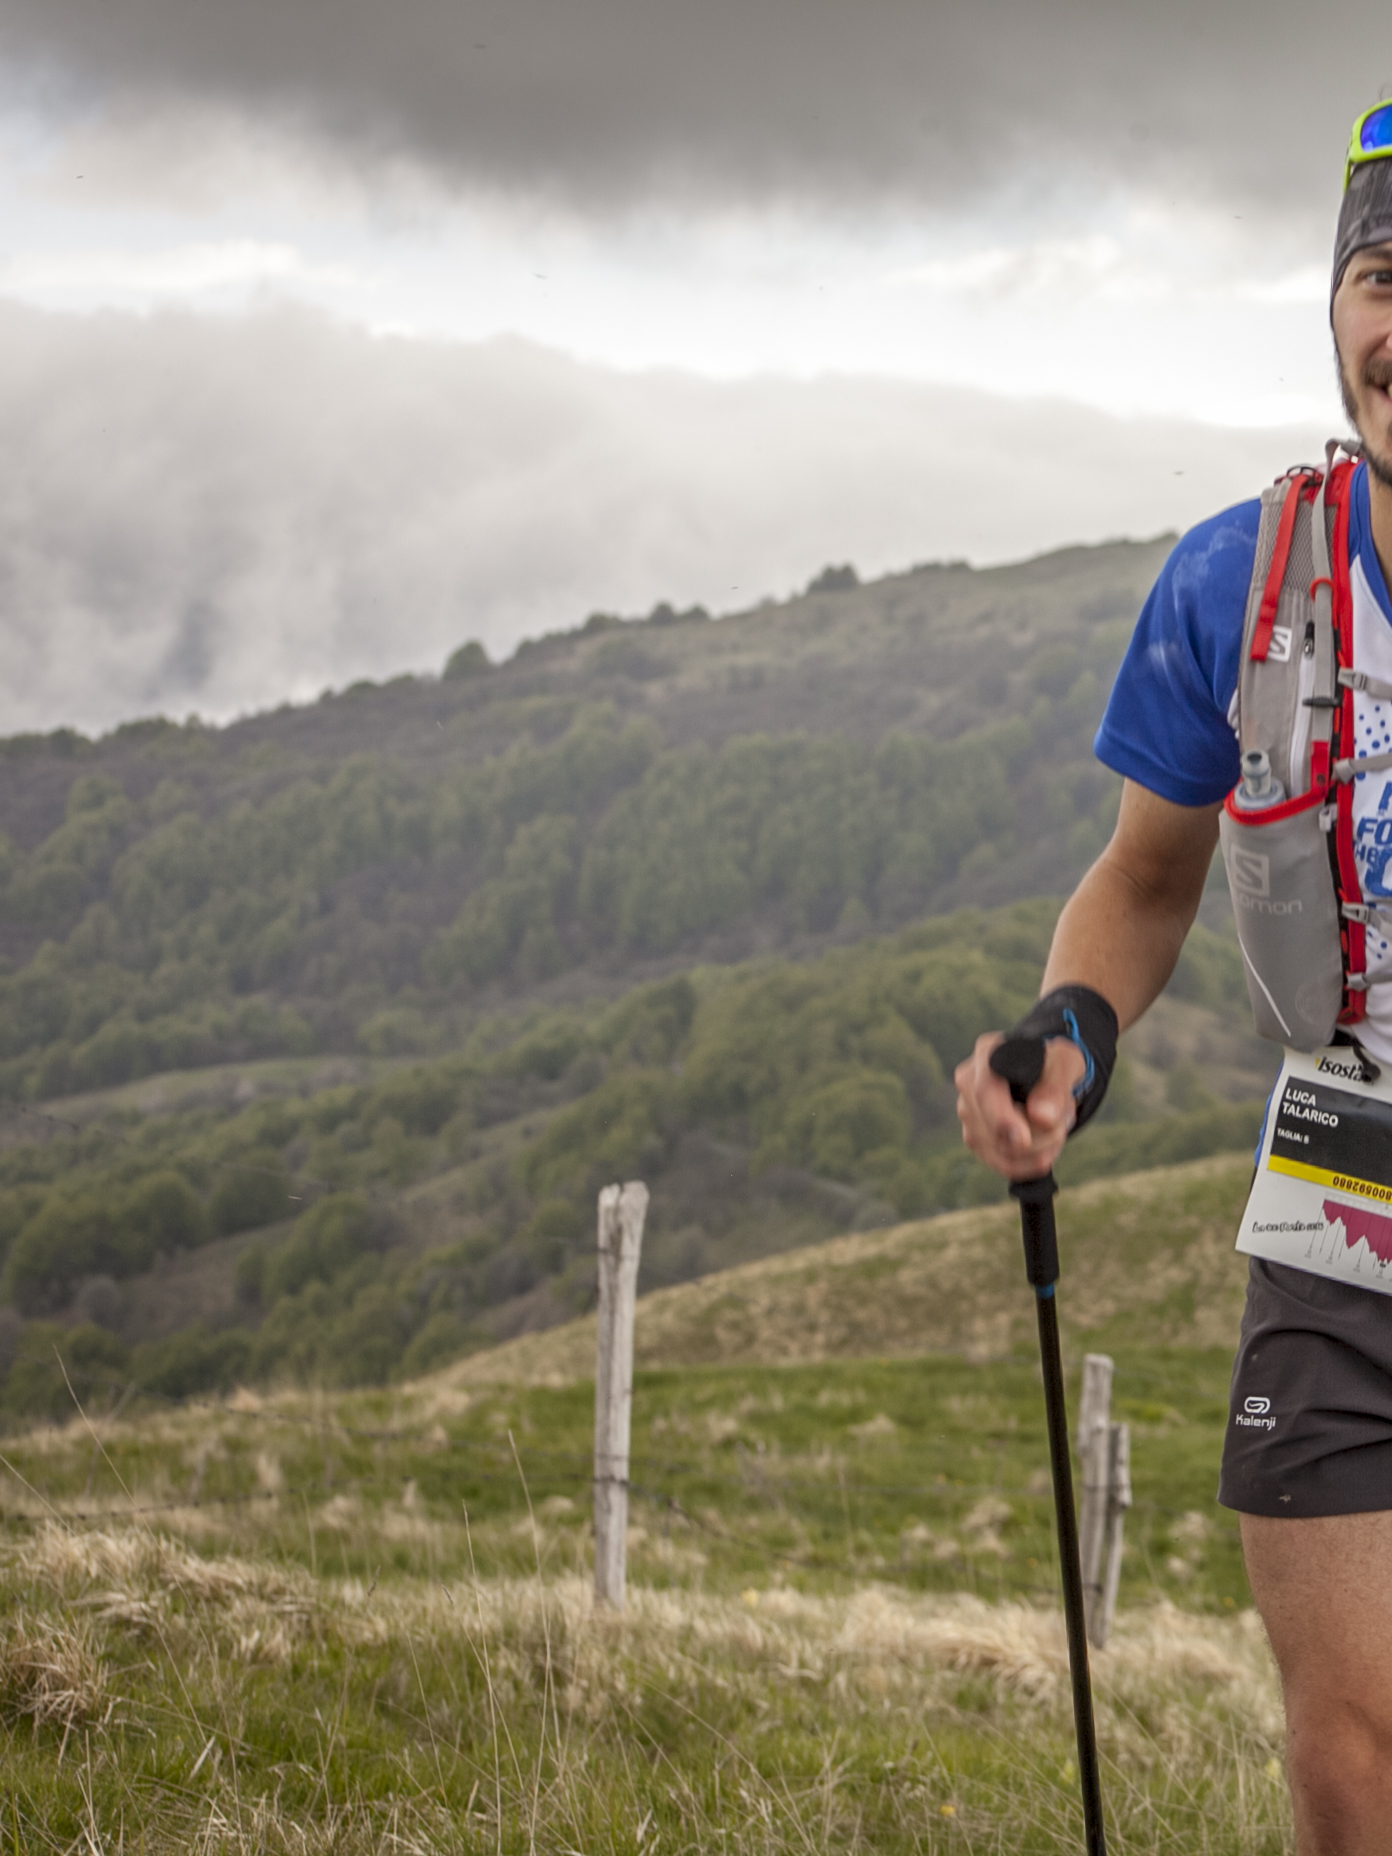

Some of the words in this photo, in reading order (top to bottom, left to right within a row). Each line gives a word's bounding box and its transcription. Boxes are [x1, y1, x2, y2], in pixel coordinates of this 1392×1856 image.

[1317, 1056, 1371, 1083] isosta
[1285, 1088, 1316, 1107] LUCA
[1282, 1102, 1339, 1128] TALARICO
[1235, 1413, 1277, 1431] Kalenji
